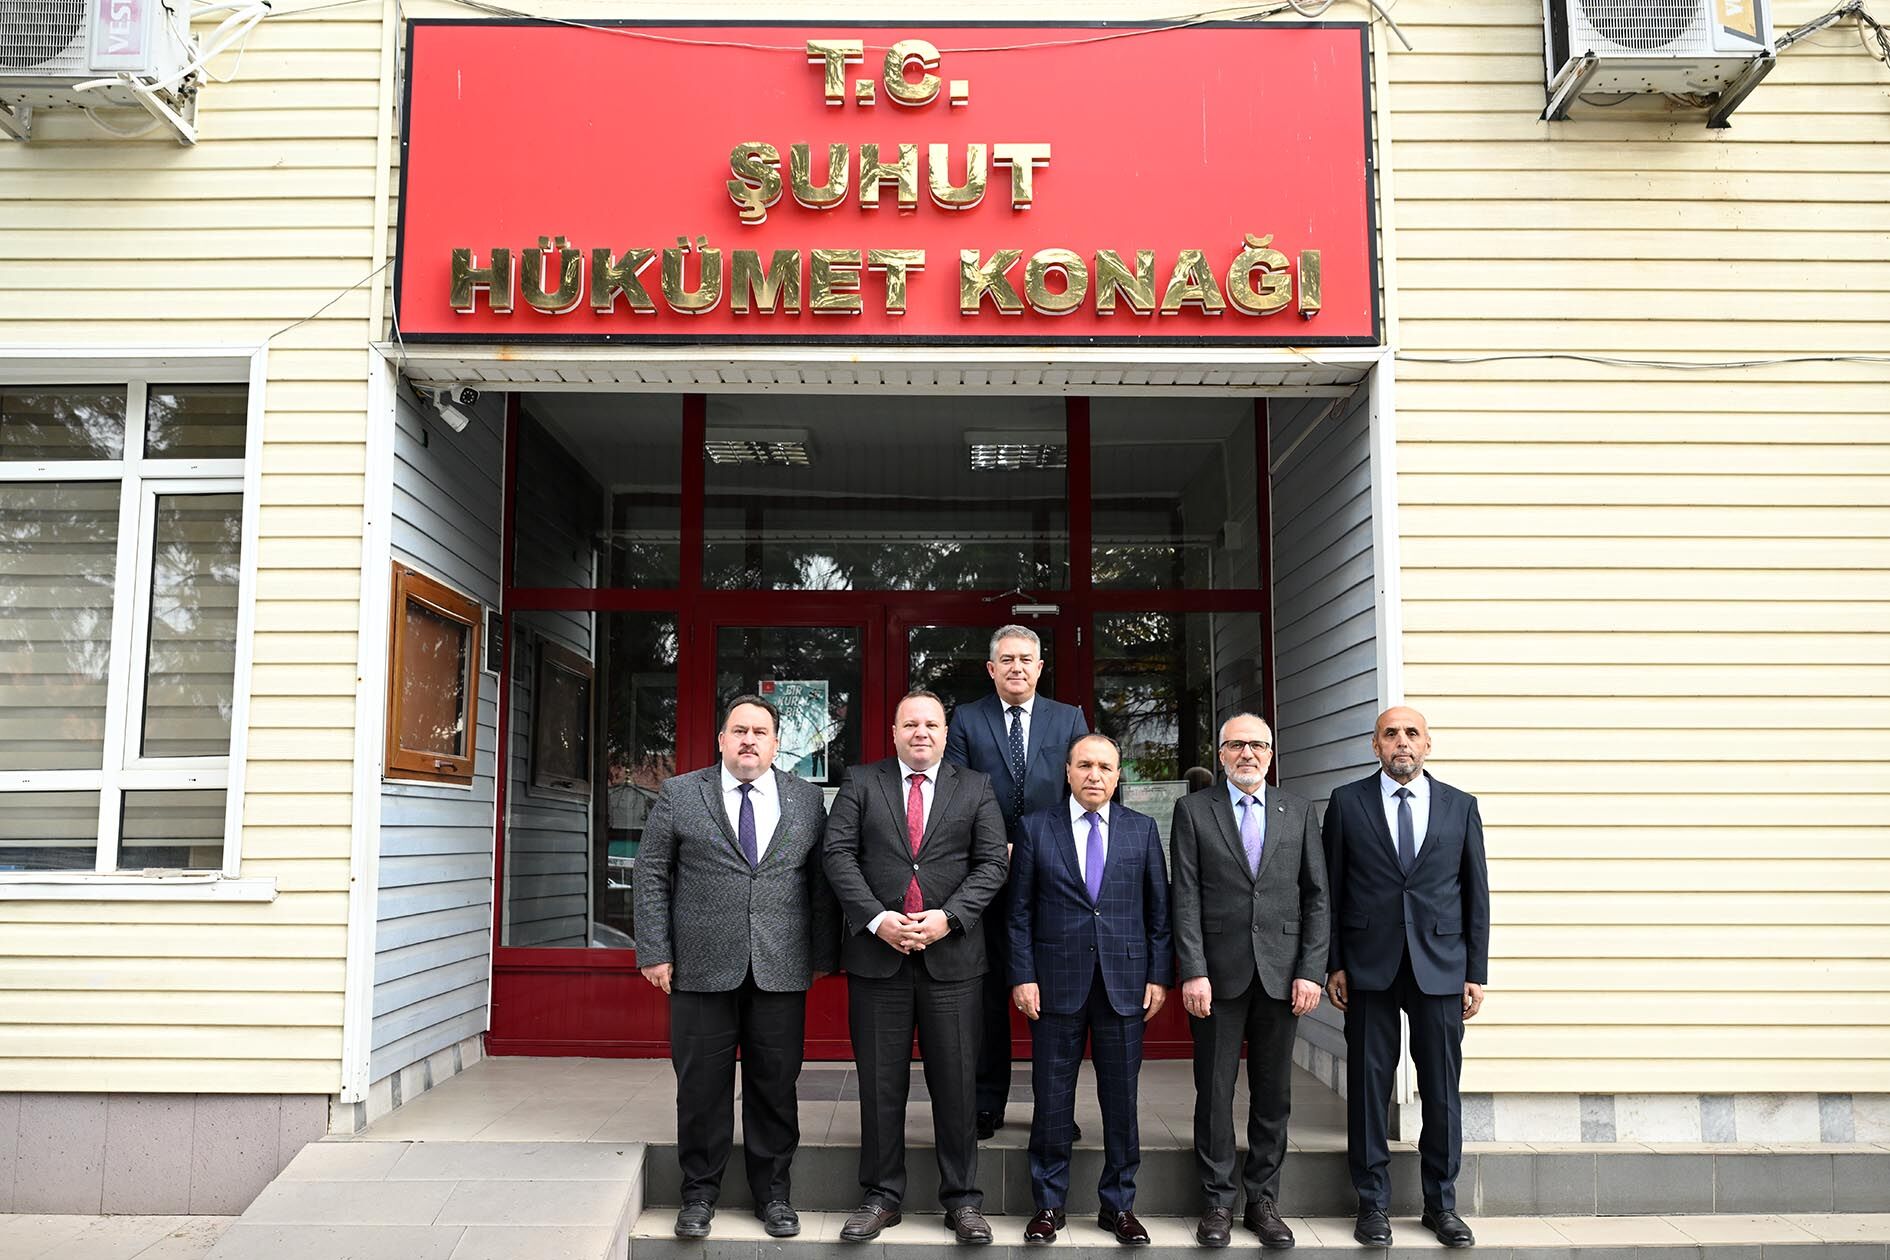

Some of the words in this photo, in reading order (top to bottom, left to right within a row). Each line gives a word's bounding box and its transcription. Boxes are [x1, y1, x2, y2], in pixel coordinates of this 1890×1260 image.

[806, 39, 969, 107] T.C.
[726, 141, 1052, 226] ŞUHUT
[449, 234, 926, 316] HÜKÜMET
[958, 233, 1322, 318] KONAĞI
